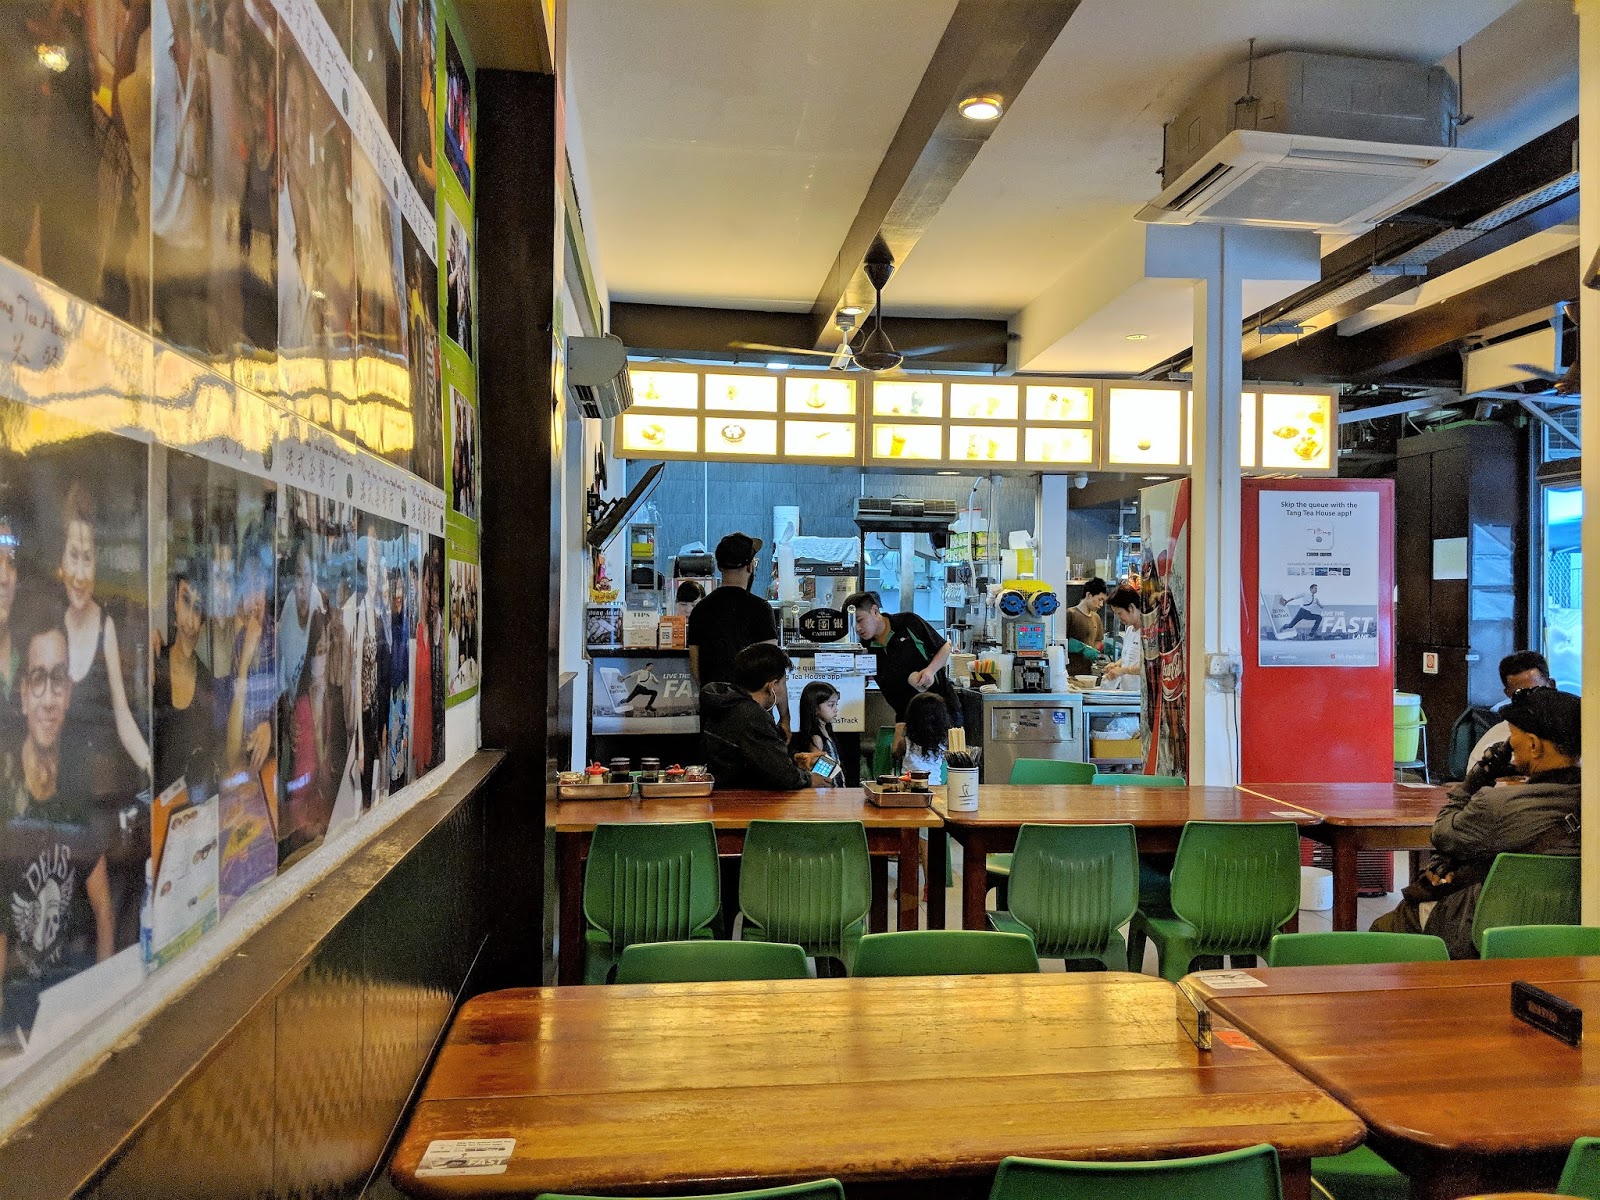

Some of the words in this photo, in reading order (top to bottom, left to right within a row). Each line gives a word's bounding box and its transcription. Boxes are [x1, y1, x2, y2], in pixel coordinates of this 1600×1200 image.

[1280, 501, 1295, 509] Skip
[1346, 501, 1358, 509] the
[1286, 509, 1302, 517] Tang
[1321, 616, 1374, 633] FAST
[828, 673, 843, 681] app!
[468, 1157, 505, 1166] FAST
